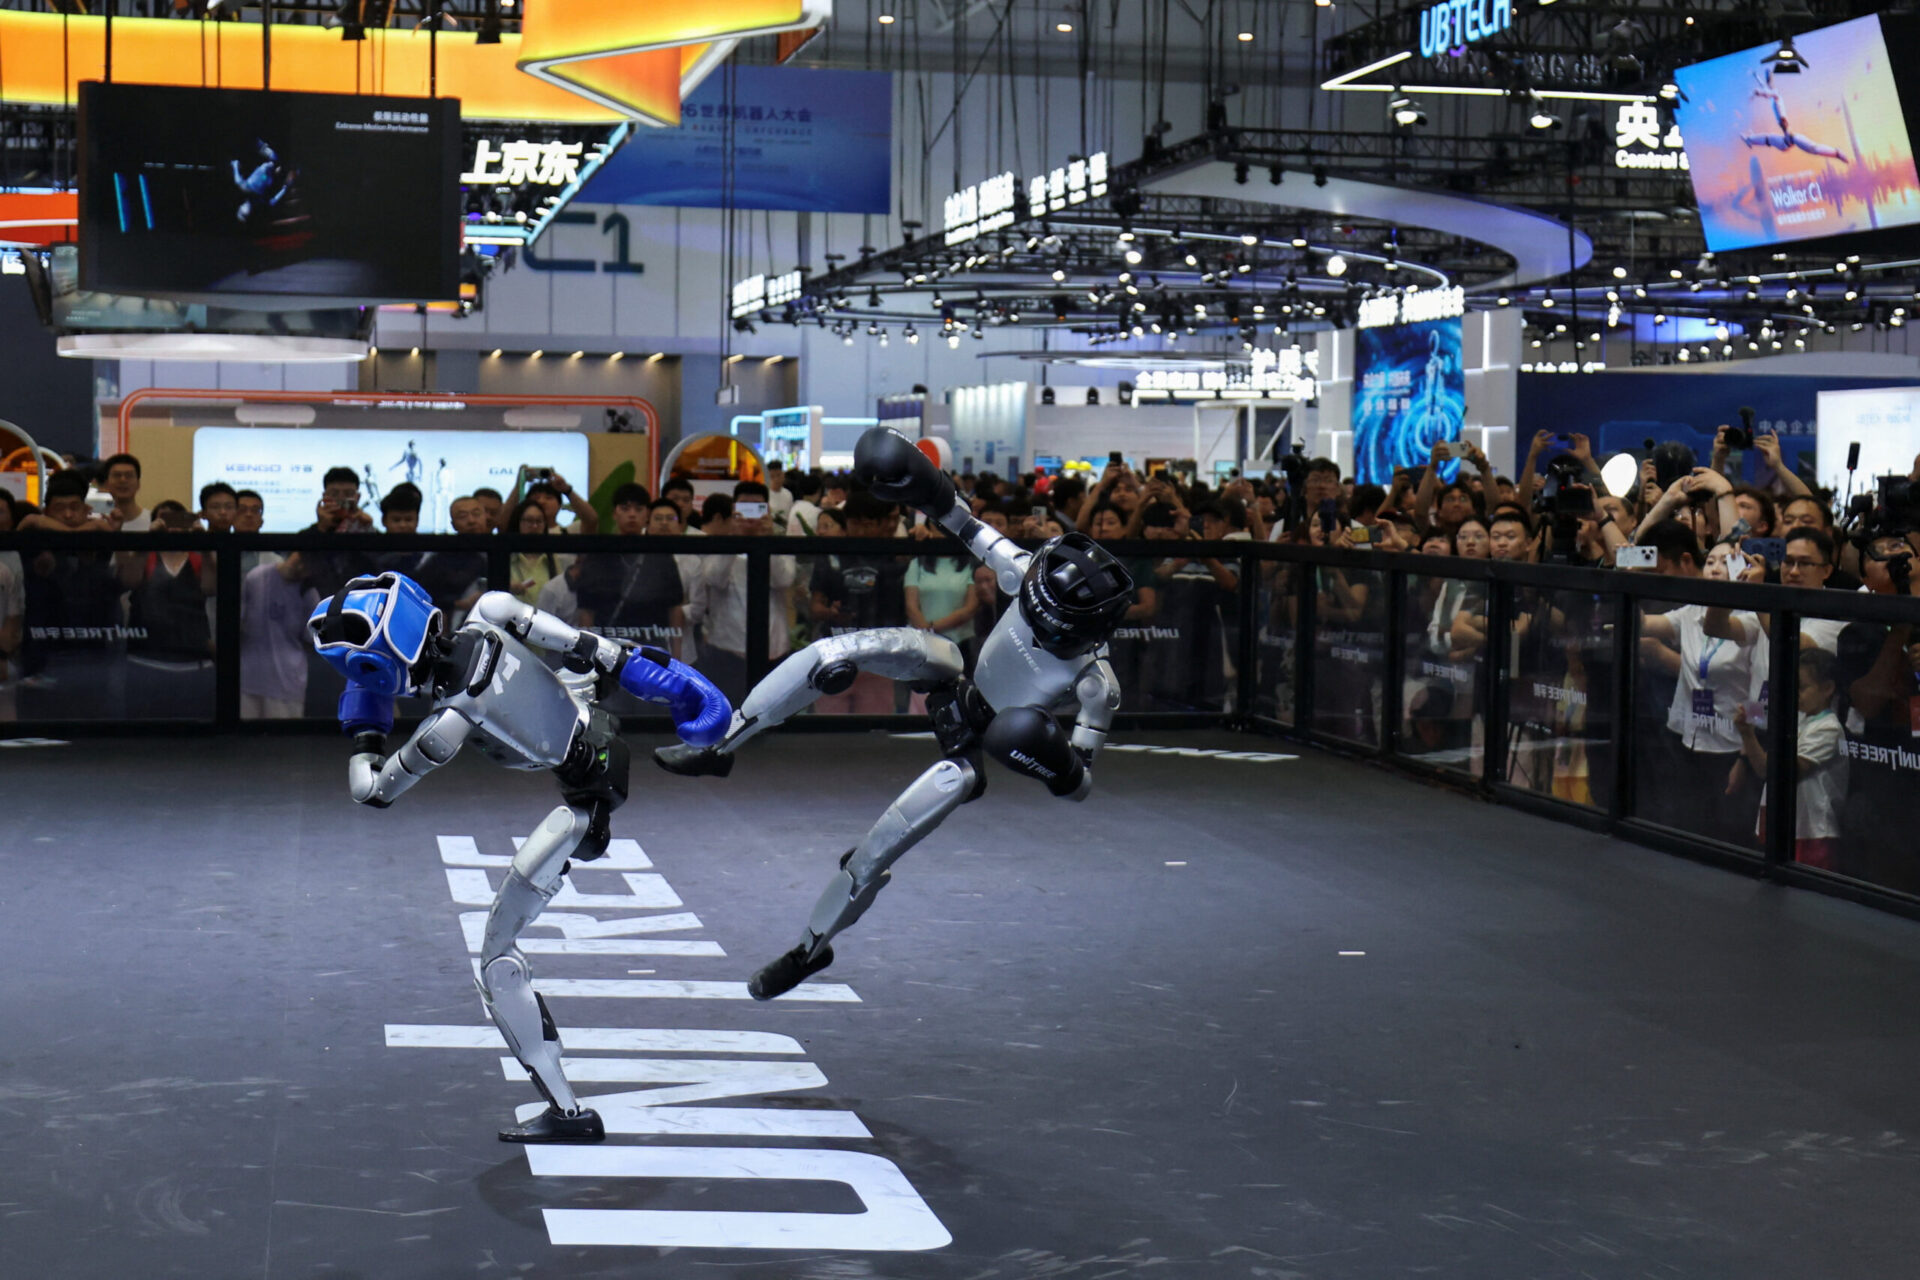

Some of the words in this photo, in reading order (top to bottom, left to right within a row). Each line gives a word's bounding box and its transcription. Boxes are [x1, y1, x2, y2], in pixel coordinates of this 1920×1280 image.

[1420, 0, 1511, 57] UBTECH
[460, 140, 583, 185] 上京东
[1770, 184, 1808, 209] Walker
[523, 211, 645, 274] C1
[385, 835, 953, 1251] UNITREE
